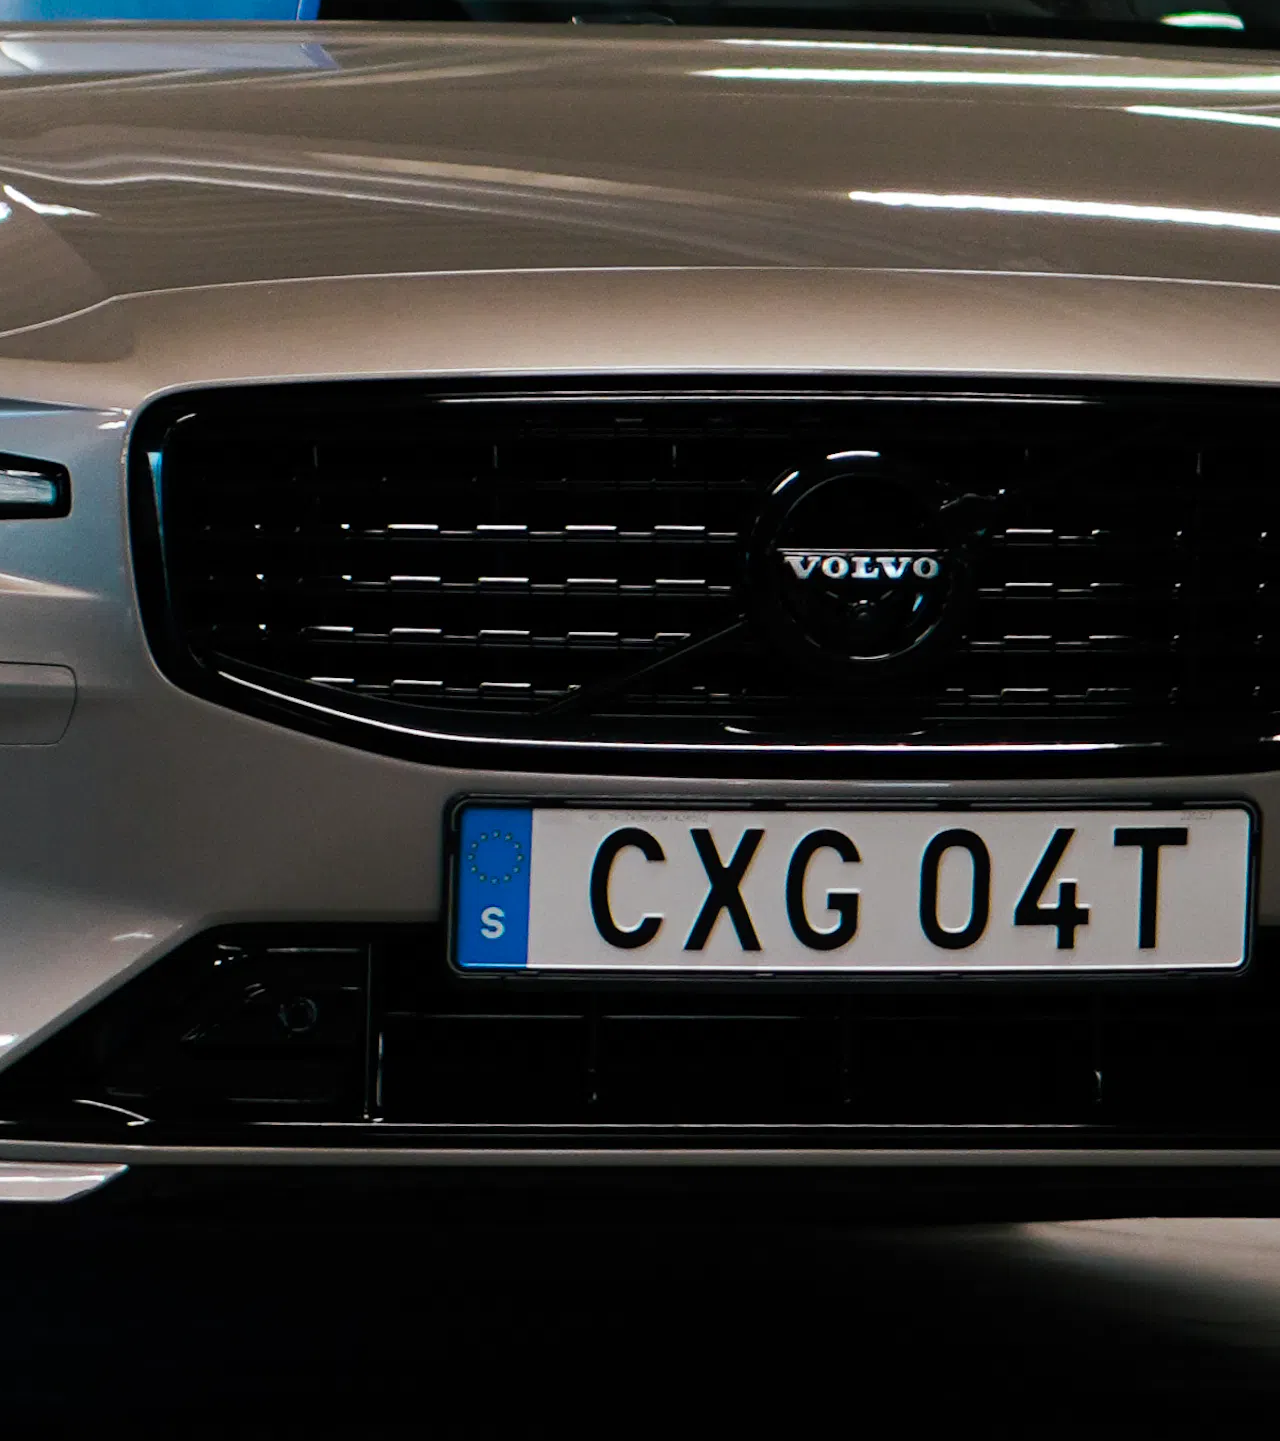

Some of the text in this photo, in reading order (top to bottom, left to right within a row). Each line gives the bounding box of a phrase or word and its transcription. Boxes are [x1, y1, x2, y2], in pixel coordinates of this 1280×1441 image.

[783, 555, 939, 580] VOLVO
[479, 827, 1189, 953] S CXG 04T
